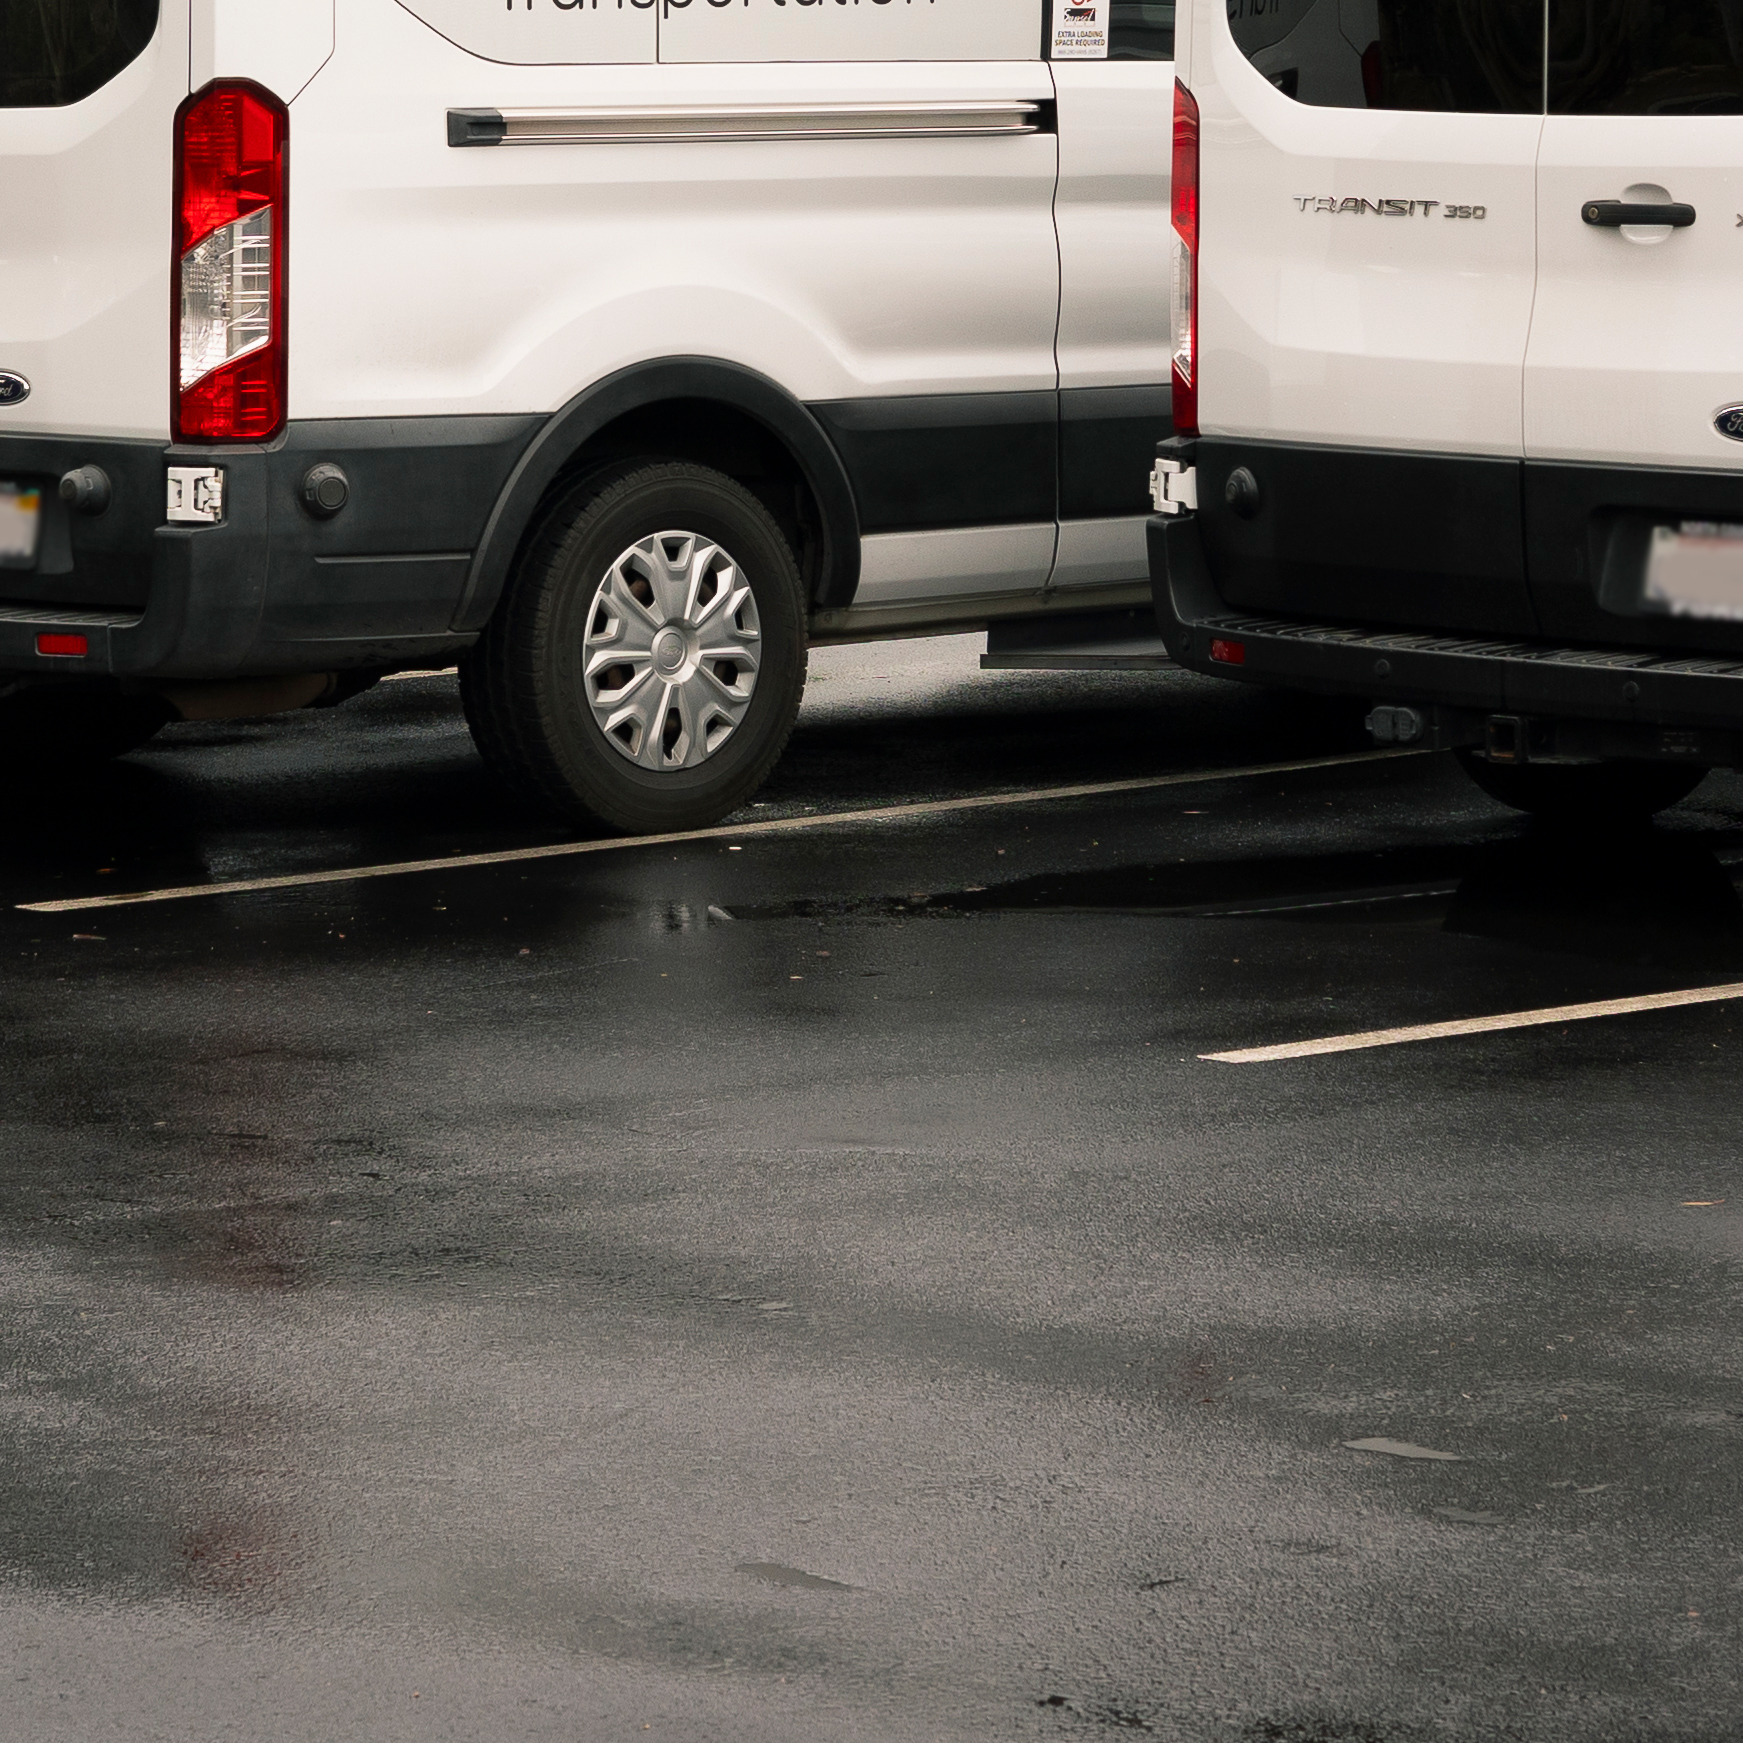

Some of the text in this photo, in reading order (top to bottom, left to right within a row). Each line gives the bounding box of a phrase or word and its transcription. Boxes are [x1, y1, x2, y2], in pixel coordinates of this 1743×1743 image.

[1058, 30, 1103, 38] EXTRA LOADING
[1054, 38, 1106, 46] SPACE REQUIRED
[1293, 195, 1487, 219] TRANSIT 350
